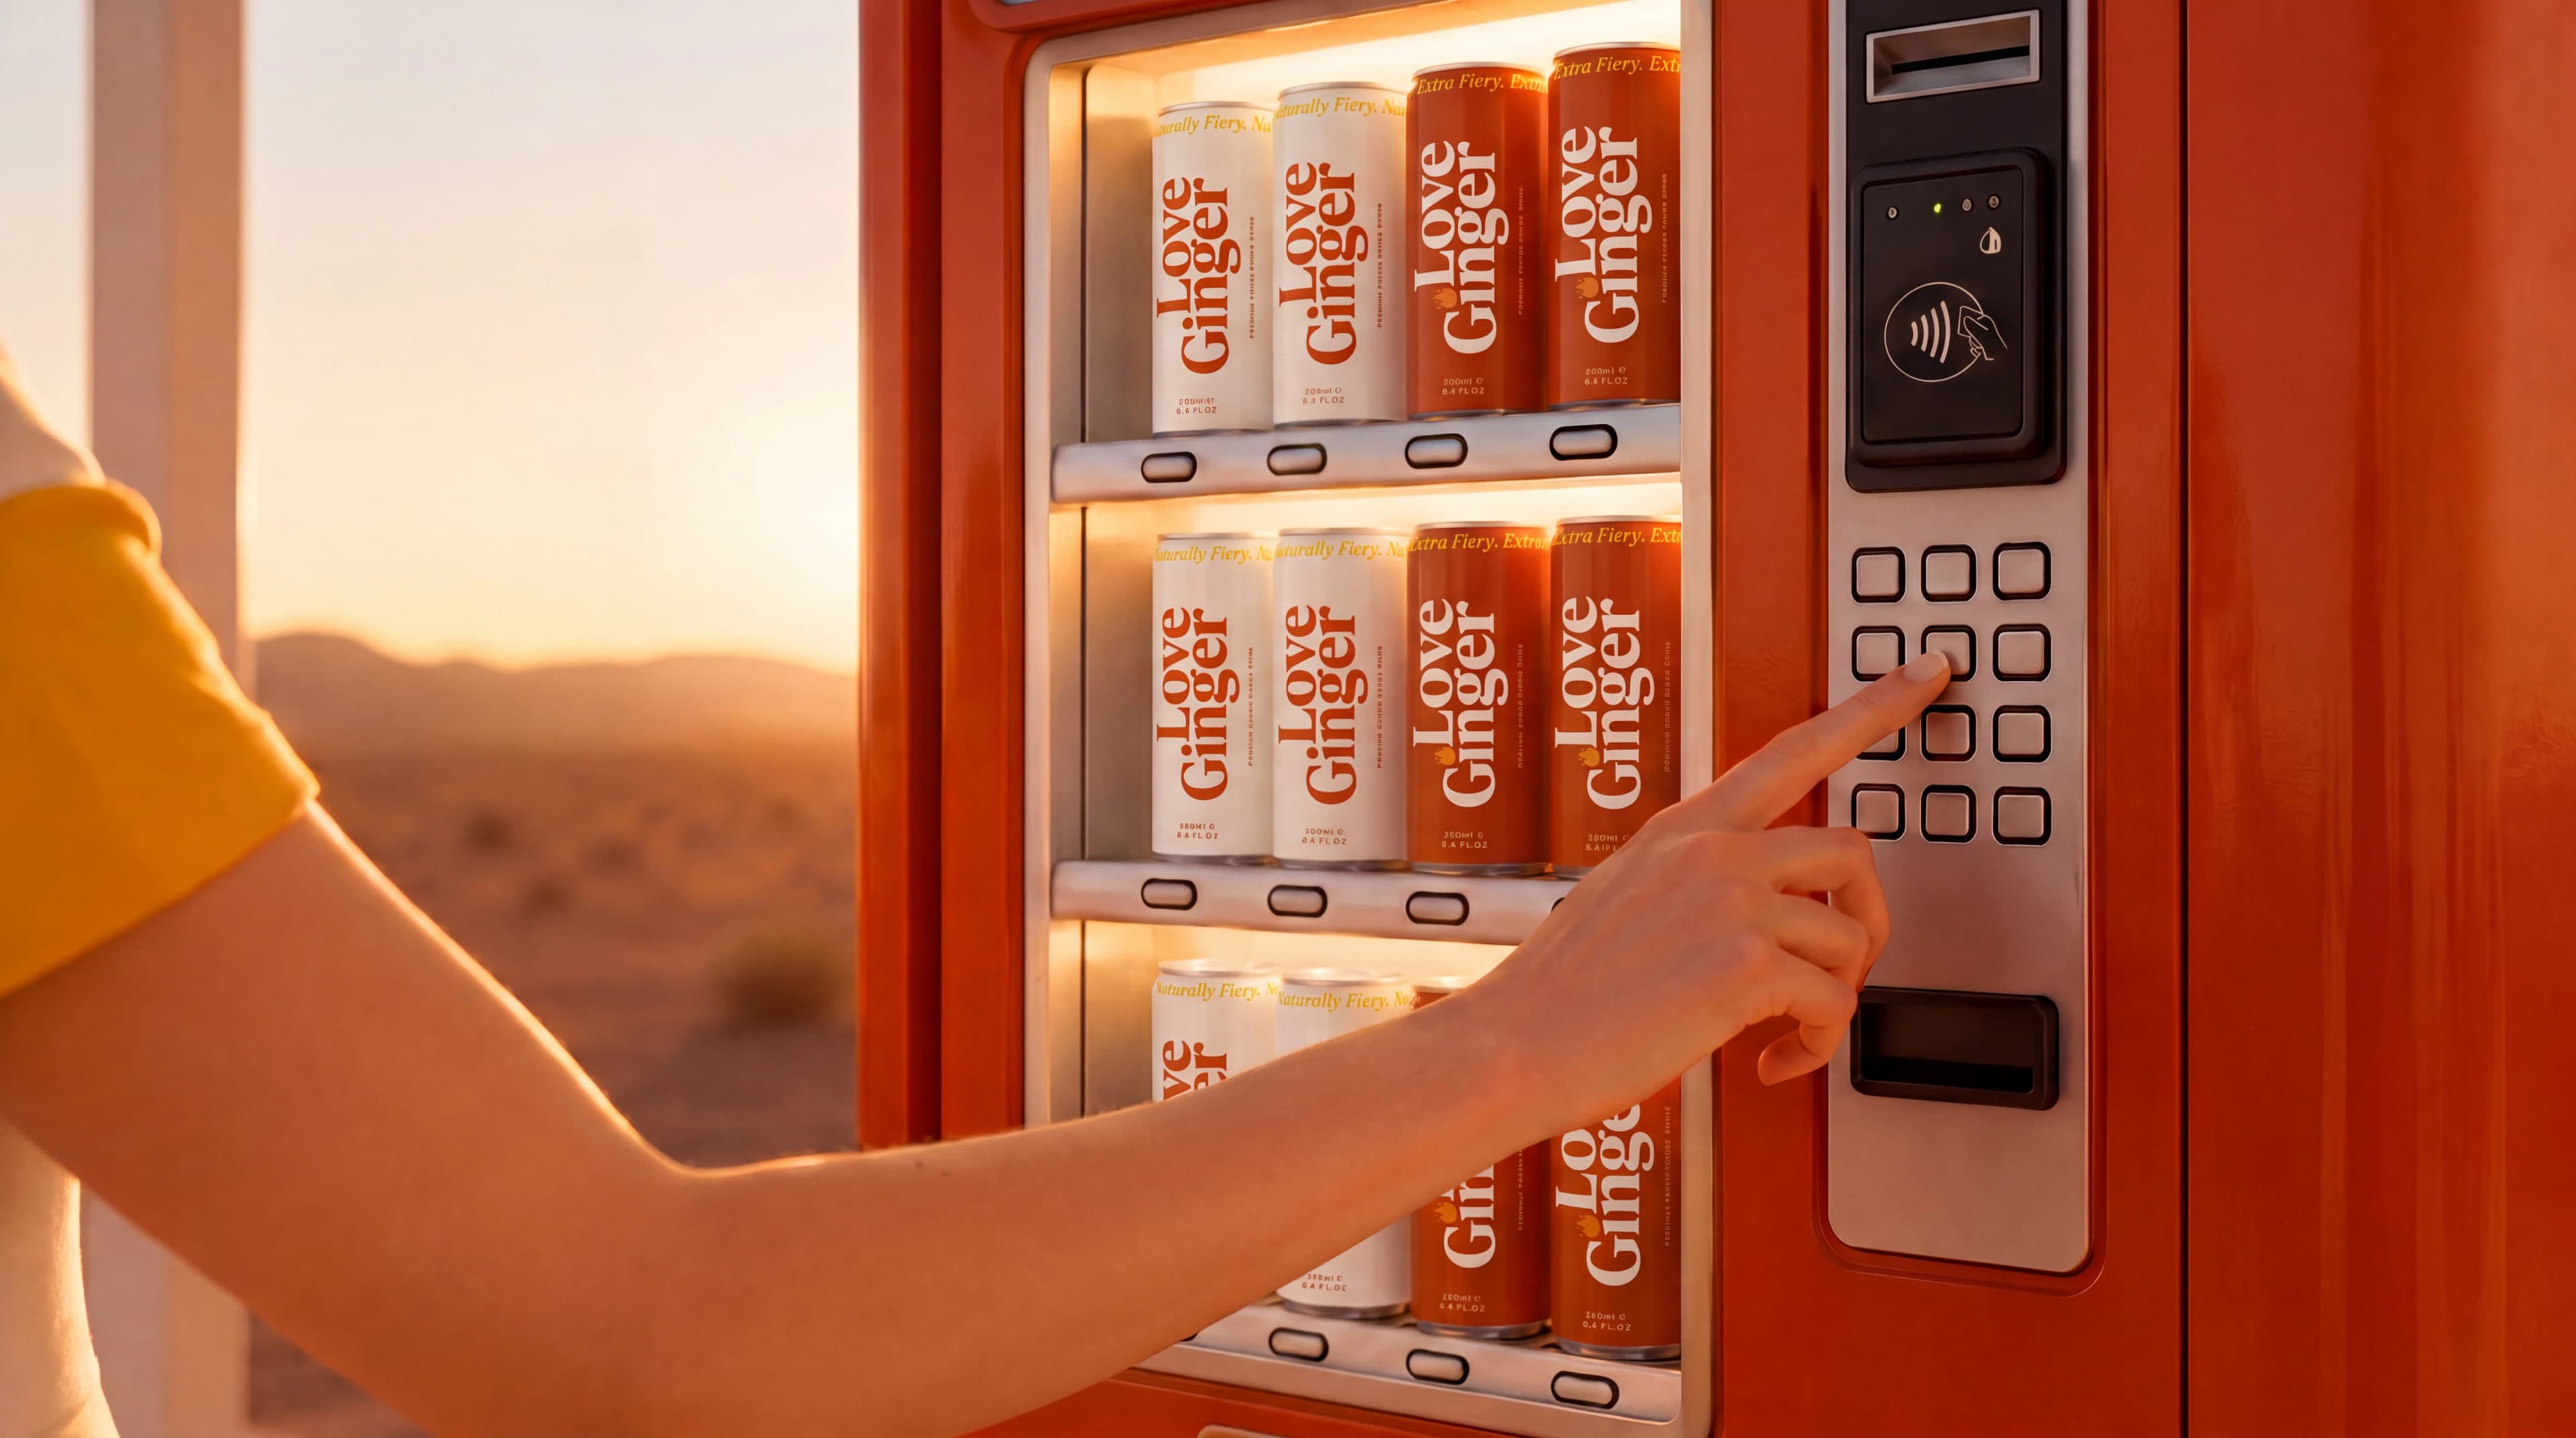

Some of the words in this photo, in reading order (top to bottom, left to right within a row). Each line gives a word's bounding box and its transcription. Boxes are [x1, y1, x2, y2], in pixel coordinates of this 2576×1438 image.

[1203, 114, 1247, 134] Fiery.
[1333, 97, 1378, 117] Fiery.
[1416, 77, 1455, 95] Extra
[1458, 73, 1504, 93] Fiery.
[1596, 56, 1644, 75] Fiery.
[1157, 177, 1191, 318] Love
[1279, 162, 1316, 307] Love
[1306, 162, 1368, 364] Ginger
[1414, 140, 1455, 292] Love
[1443, 141, 1509, 354] Ginger
[1554, 125, 1597, 282] Love
[1584, 126, 1652, 344] Ginger
[1181, 178, 1241, 374] Ginger
[1210, 546, 1252, 564] Fiery.
[1338, 540, 1381, 560] Fiery.
[1450, 533, 1498, 552] Fiery.
[1597, 527, 1646, 547] Fiery.
[1157, 607, 1190, 742] Love
[1181, 607, 1240, 800] Ginger
[1279, 605, 1316, 744] Love
[1306, 606, 1368, 805] Ginger
[1413, 598, 1454, 747] Love
[1442, 600, 1509, 807] Ginger
[1554, 595, 1597, 748] Love
[1587, 597, 1654, 810] Ginger
[1218, 982, 1260, 1002] Fiery.
[1345, 992, 1389, 1013] Fiery.
[1163, 1040, 1191, 1101] ve
[1444, 1164, 1495, 1268] Gin
[1556, 1129, 1597, 1214] Lo
[1586, 1103, 1654, 1286] Ginge
